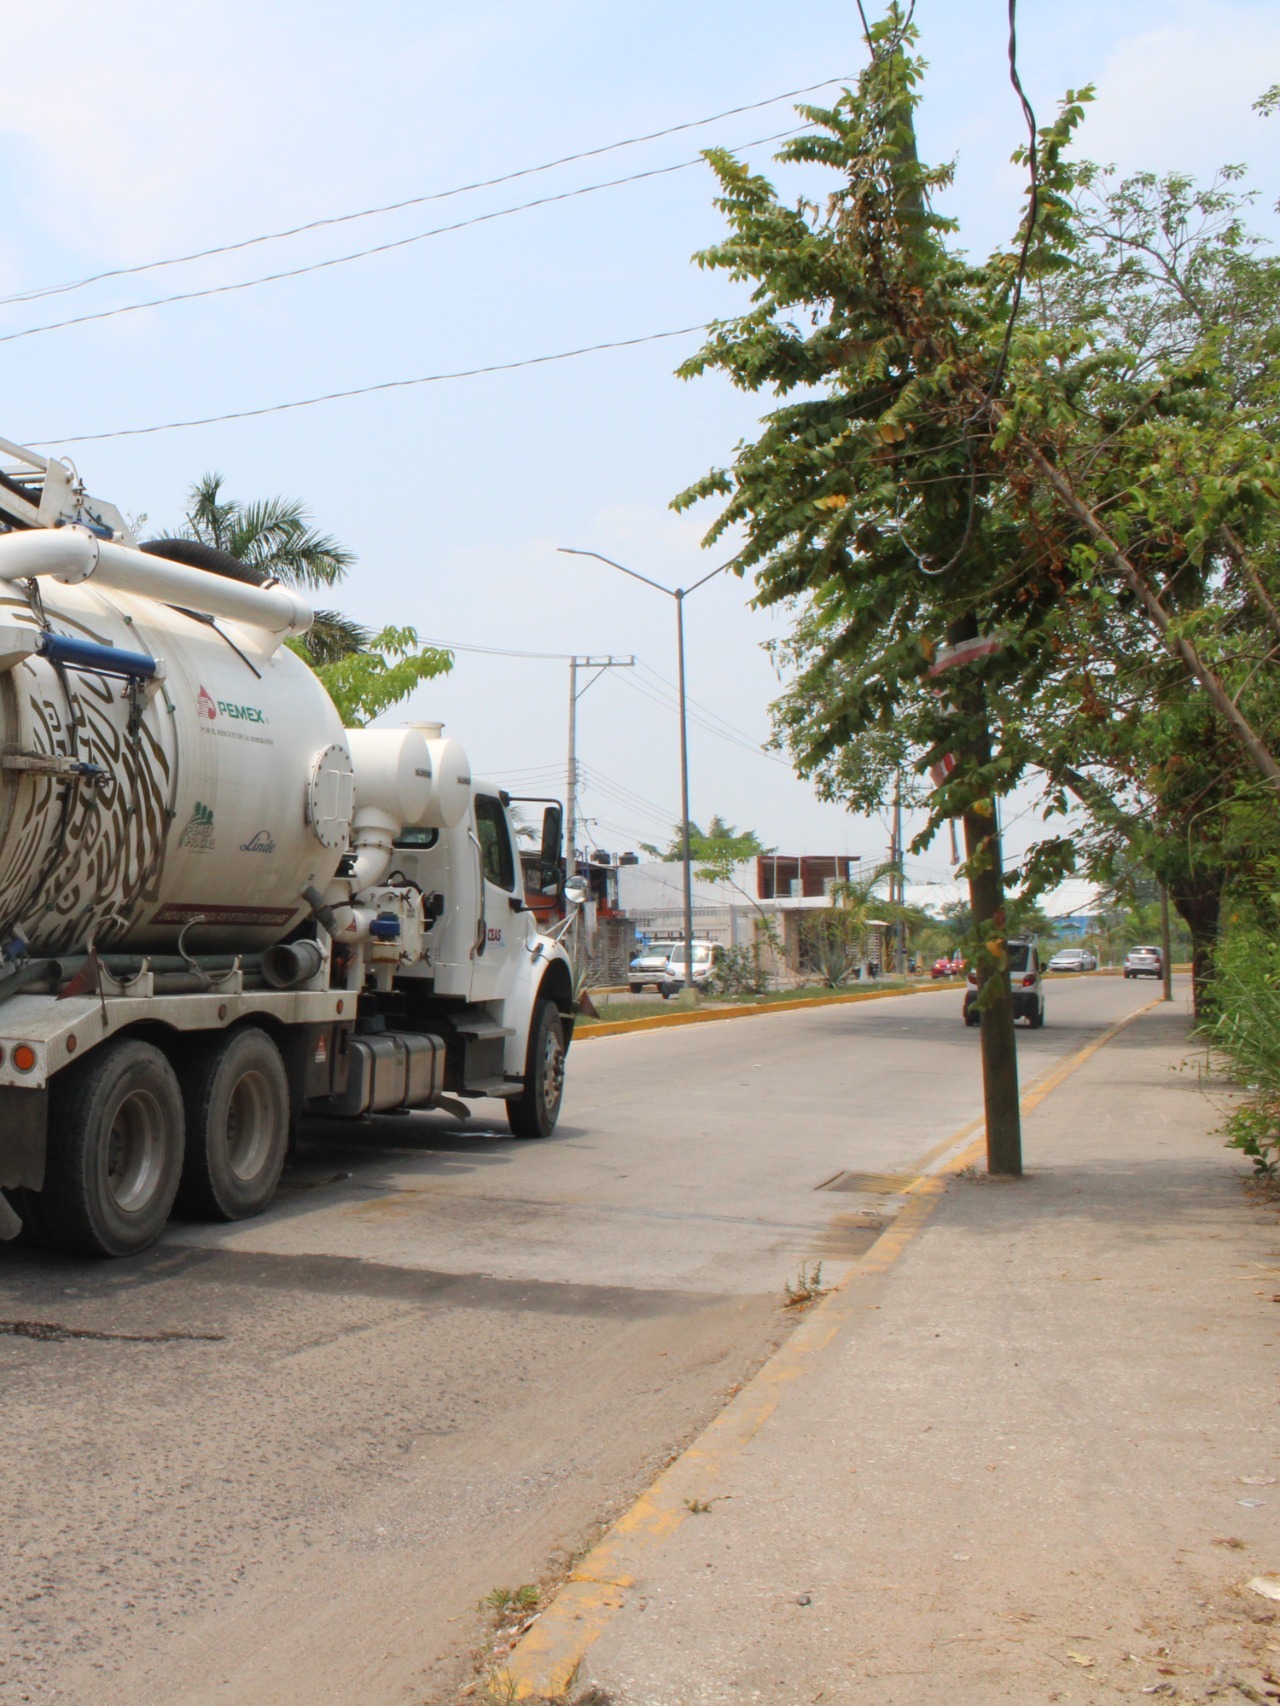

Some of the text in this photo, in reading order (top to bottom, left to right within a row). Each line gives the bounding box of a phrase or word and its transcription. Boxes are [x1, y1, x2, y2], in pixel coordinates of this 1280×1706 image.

[217, 701, 265, 724] PEMEX
[239, 830, 276, 853] Linde
[487, 928, 501, 942] CEAS
